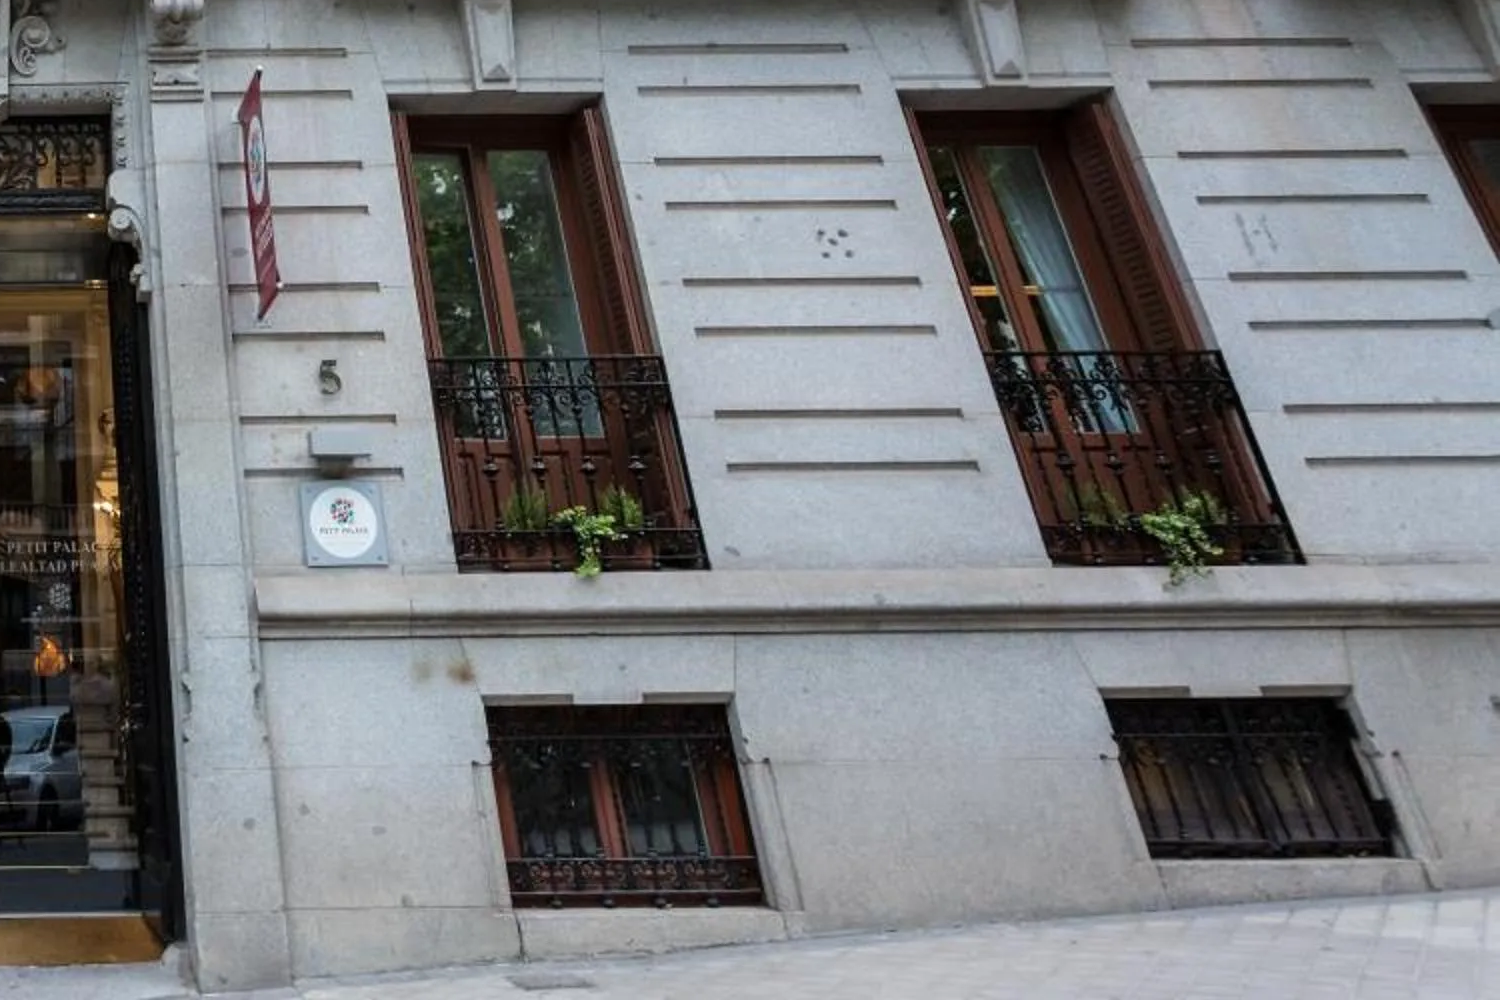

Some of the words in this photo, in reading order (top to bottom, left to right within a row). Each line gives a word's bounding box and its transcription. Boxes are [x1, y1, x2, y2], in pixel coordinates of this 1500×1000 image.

[319, 359, 342, 395] 5
[6, 541, 48, 554] PETIT
[53, 541, 105, 553] PALAC
[0, 560, 67, 573] LEALTAD
